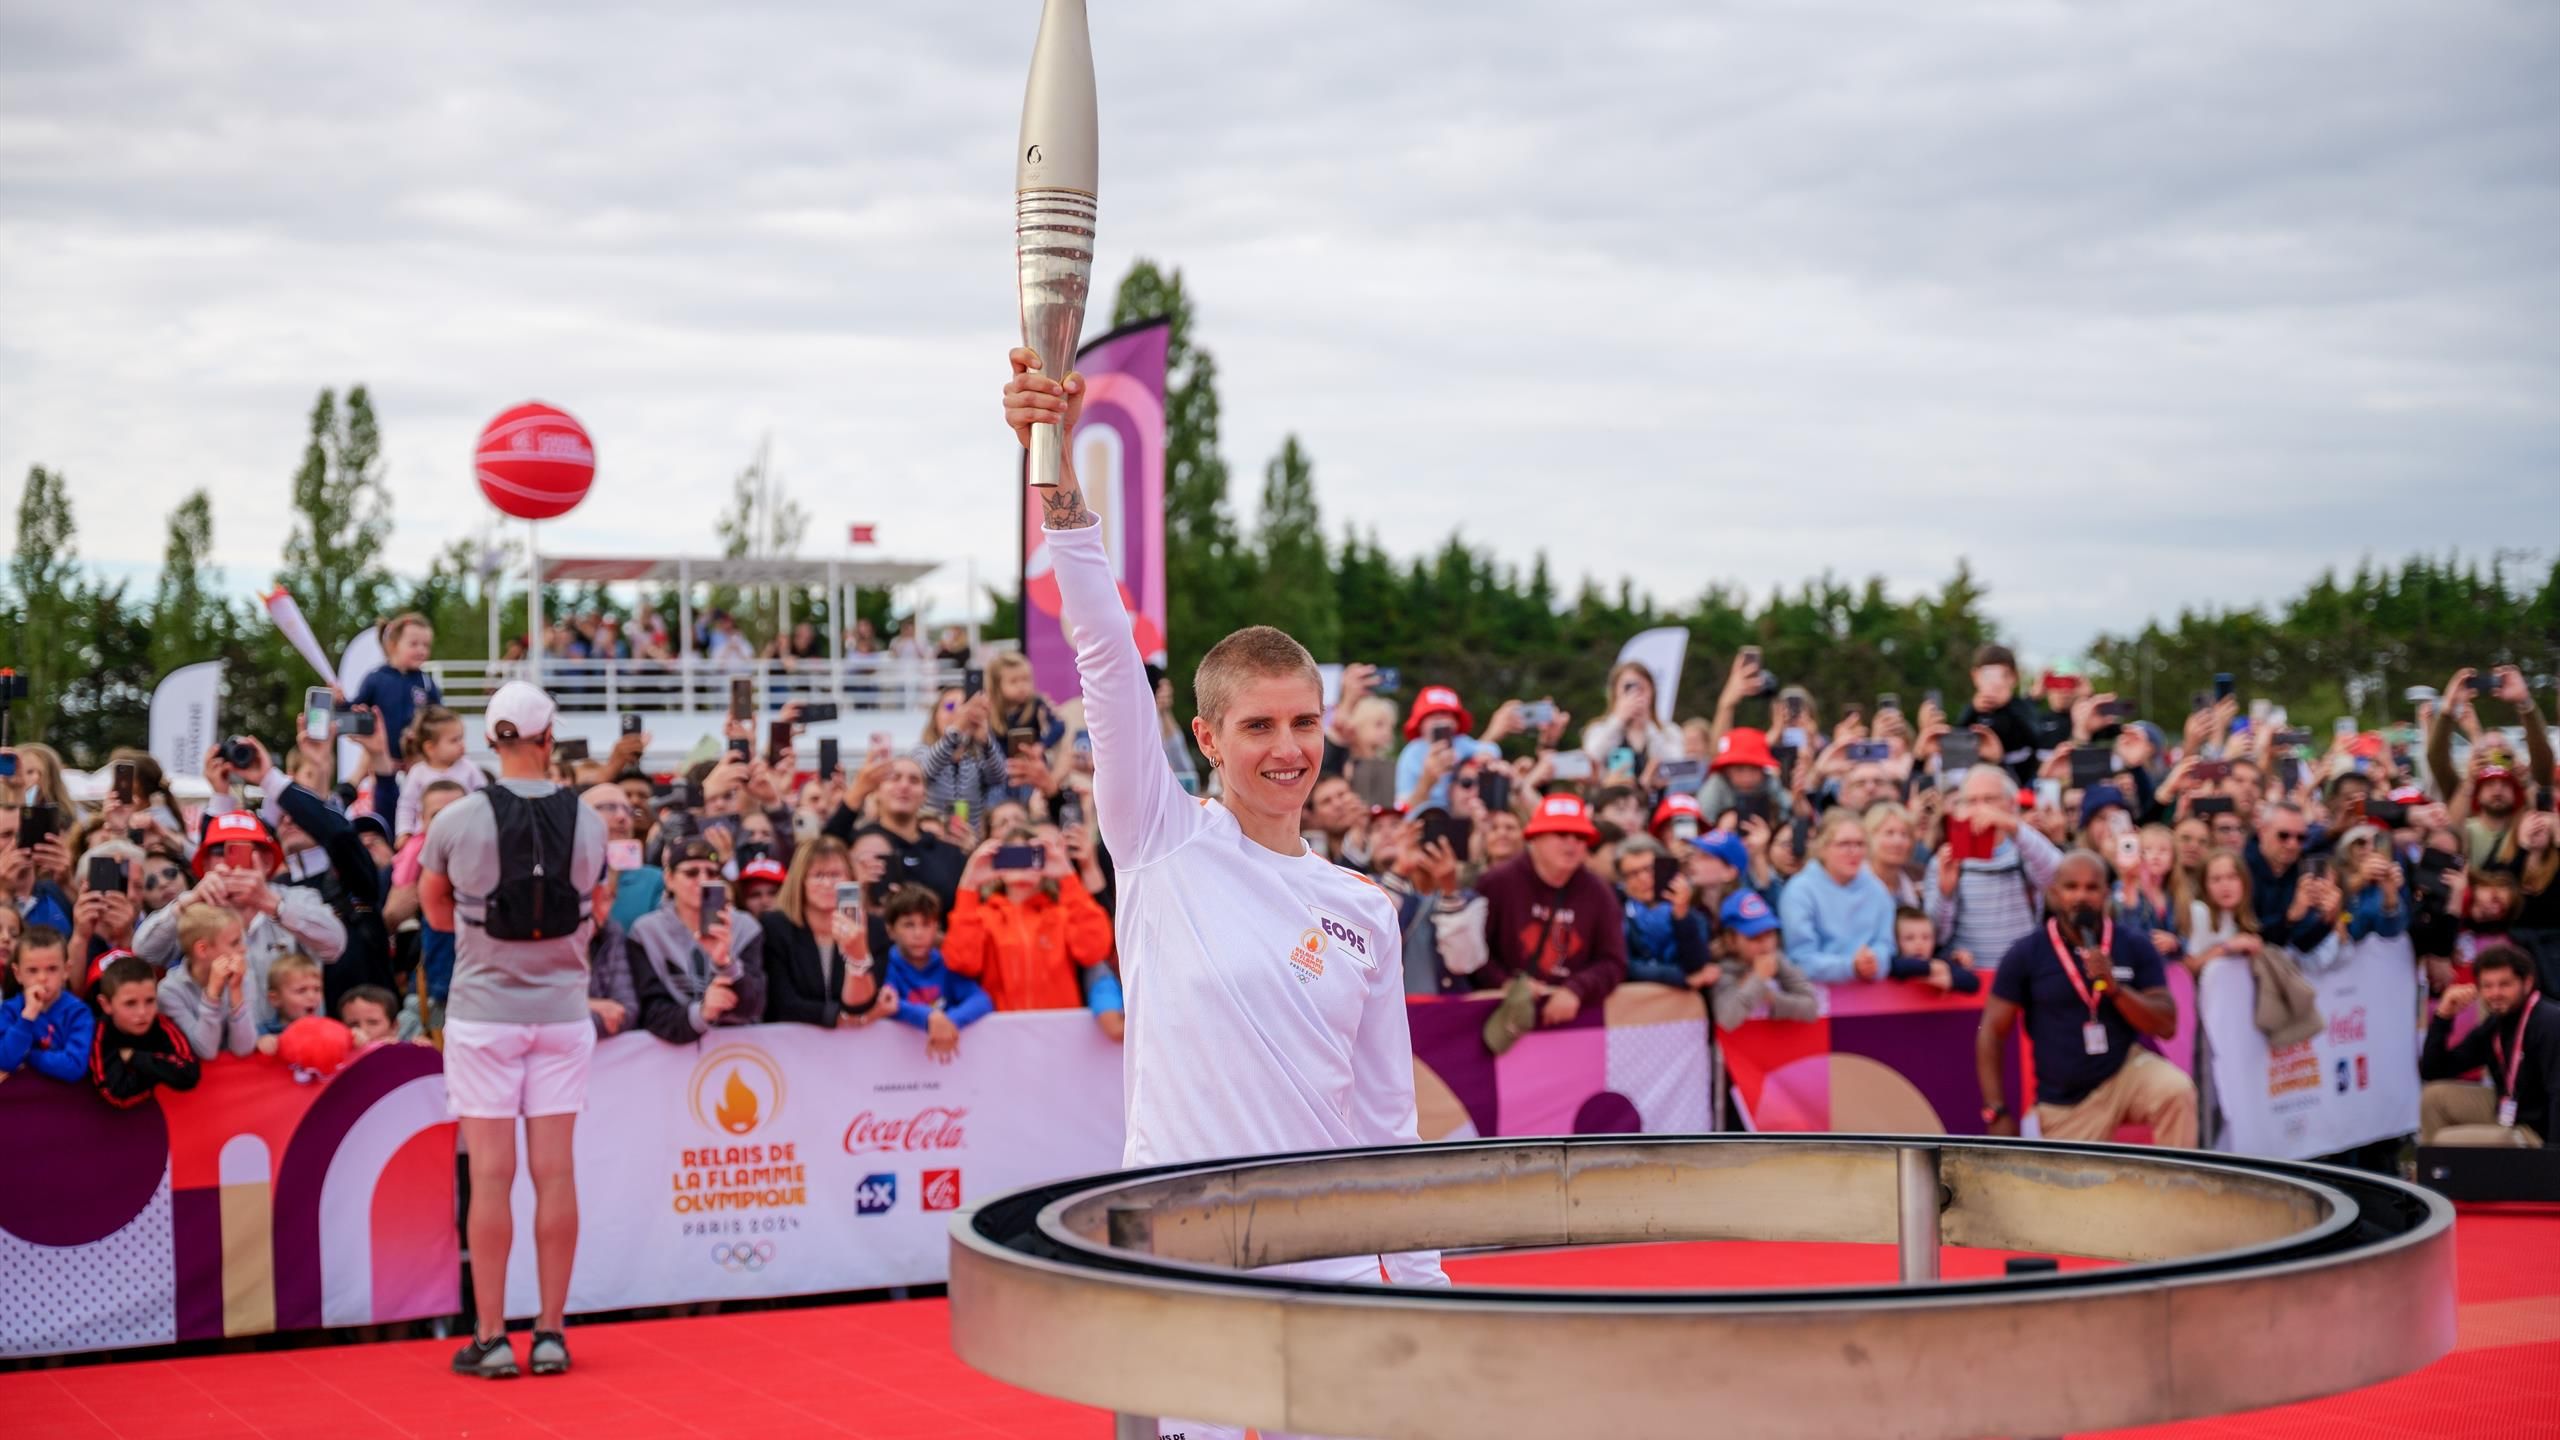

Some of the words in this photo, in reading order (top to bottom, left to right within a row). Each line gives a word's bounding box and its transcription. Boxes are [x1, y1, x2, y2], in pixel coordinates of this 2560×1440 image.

[682, 1146, 763, 1168] RELAIS
[769, 1143, 796, 1162] DE
[672, 1171, 701, 1191] LA
[707, 1165, 806, 1188] FLAMME
[673, 1186, 807, 1214] OLYMPIQUE
[682, 1219, 743, 1236] PARIS
[749, 1215, 801, 1234] 2024
